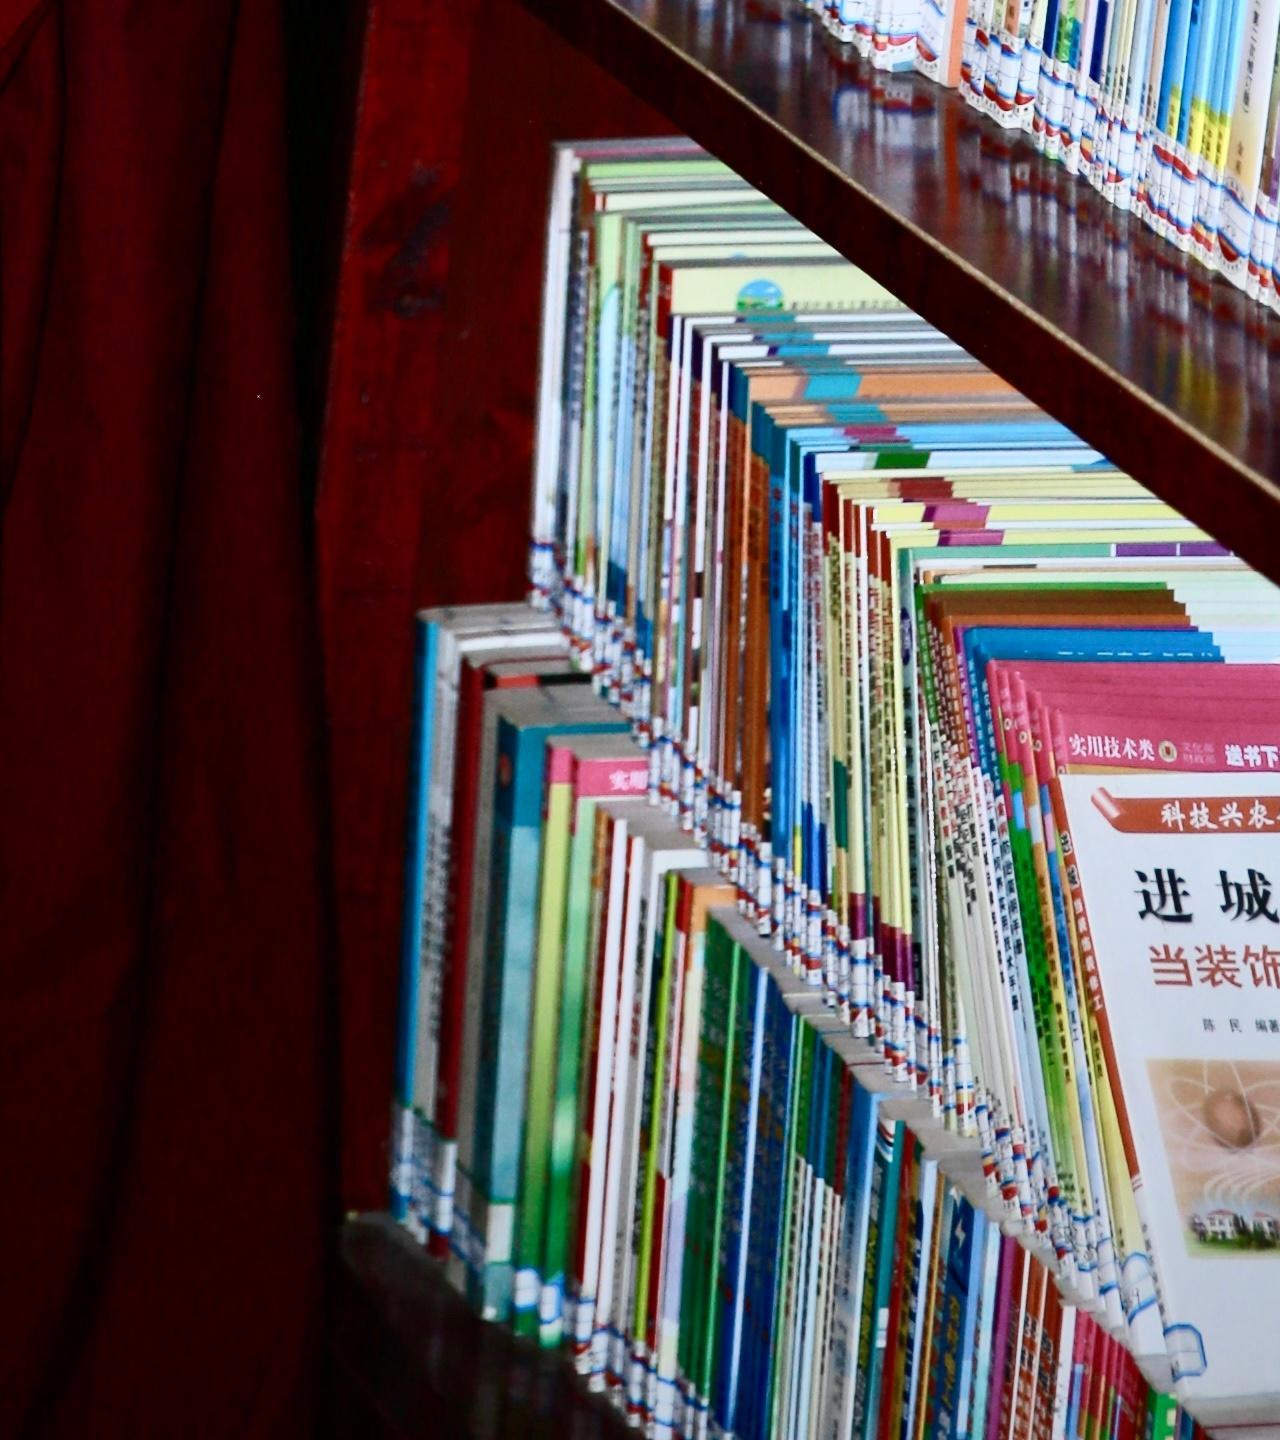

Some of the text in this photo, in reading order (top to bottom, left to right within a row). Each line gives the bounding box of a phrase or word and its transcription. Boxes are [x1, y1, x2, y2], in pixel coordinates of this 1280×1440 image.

[1068, 734, 1155, 763] 实用技术类
[1133, 867, 1280, 924] 进城
